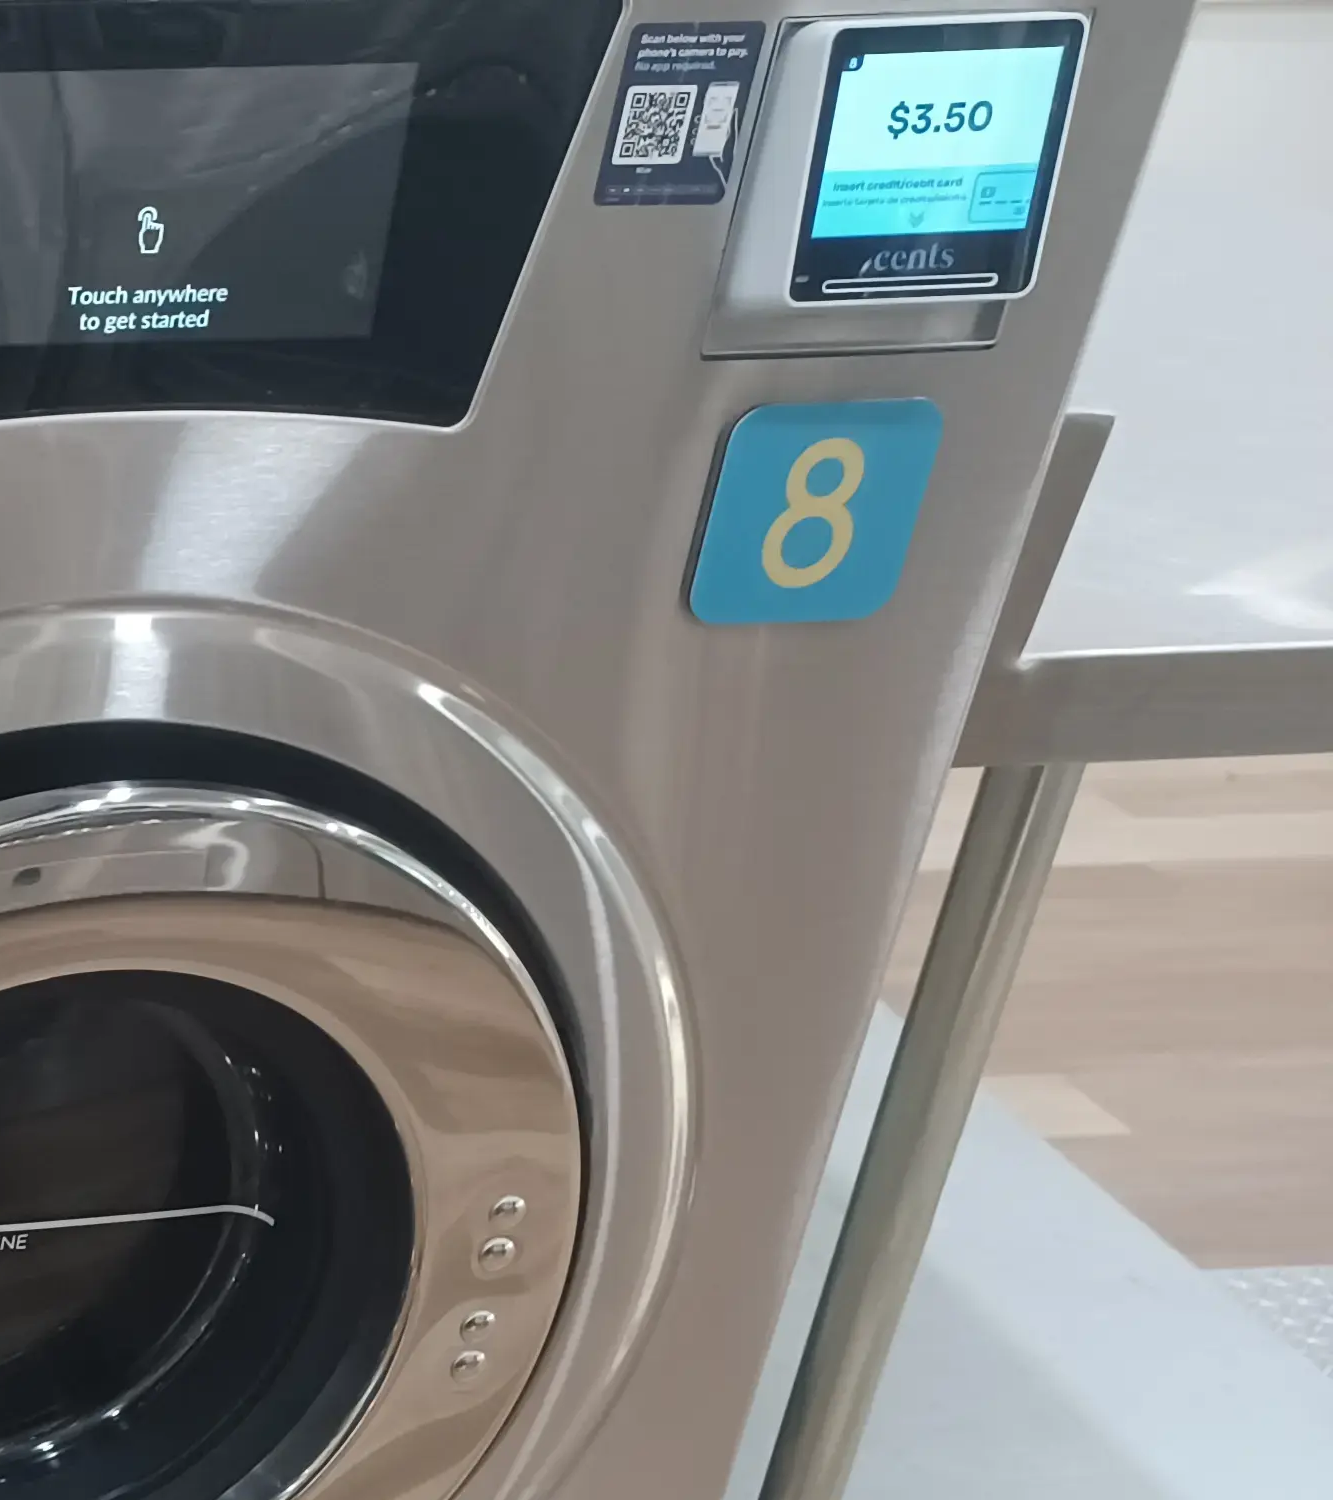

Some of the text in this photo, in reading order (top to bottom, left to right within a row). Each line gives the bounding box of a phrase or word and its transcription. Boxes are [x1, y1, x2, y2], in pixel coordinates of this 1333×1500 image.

[641, 33, 745, 45] Scan below with your
[637, 48, 676, 60] phone's
[716, 47, 726, 56] to
[848, 56, 859, 70] 8
[887, 100, 994, 140] $3.50
[872, 242, 955, 271] cents
[68, 284, 229, 307] Touch anywhere
[79, 309, 211, 334] to get started
[761, 437, 865, 588] 8
